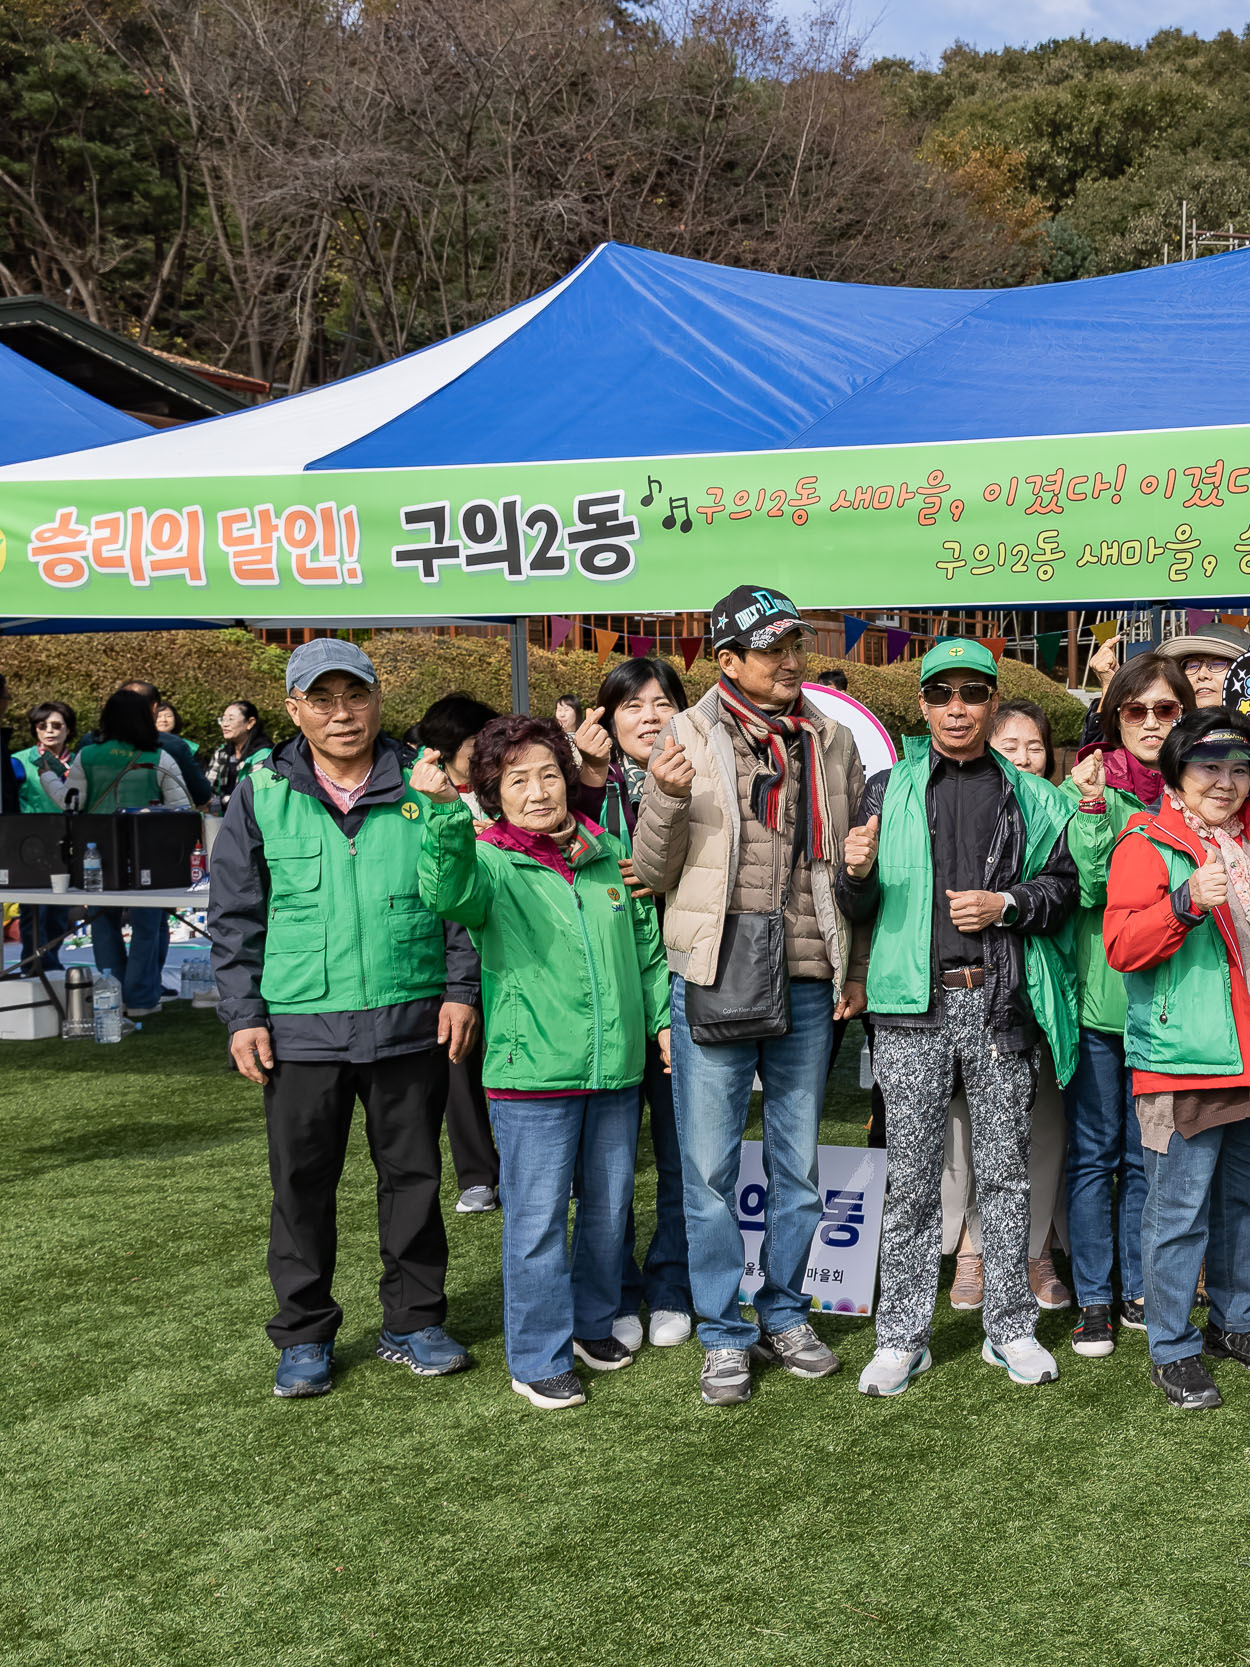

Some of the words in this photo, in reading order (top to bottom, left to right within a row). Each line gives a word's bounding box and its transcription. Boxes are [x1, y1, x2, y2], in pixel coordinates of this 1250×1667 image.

[695, 475, 821, 526] 구의2동
[829, 468, 966, 526] 새마을,
[982, 463, 1128, 516] 이겼다!
[29, 506, 206, 585] 승리의
[218, 503, 361, 583] 달인!
[394, 492, 637, 579] 구의2동
[935, 528, 1066, 582] 구의2동
[1076, 522, 1218, 582] 새마을,
